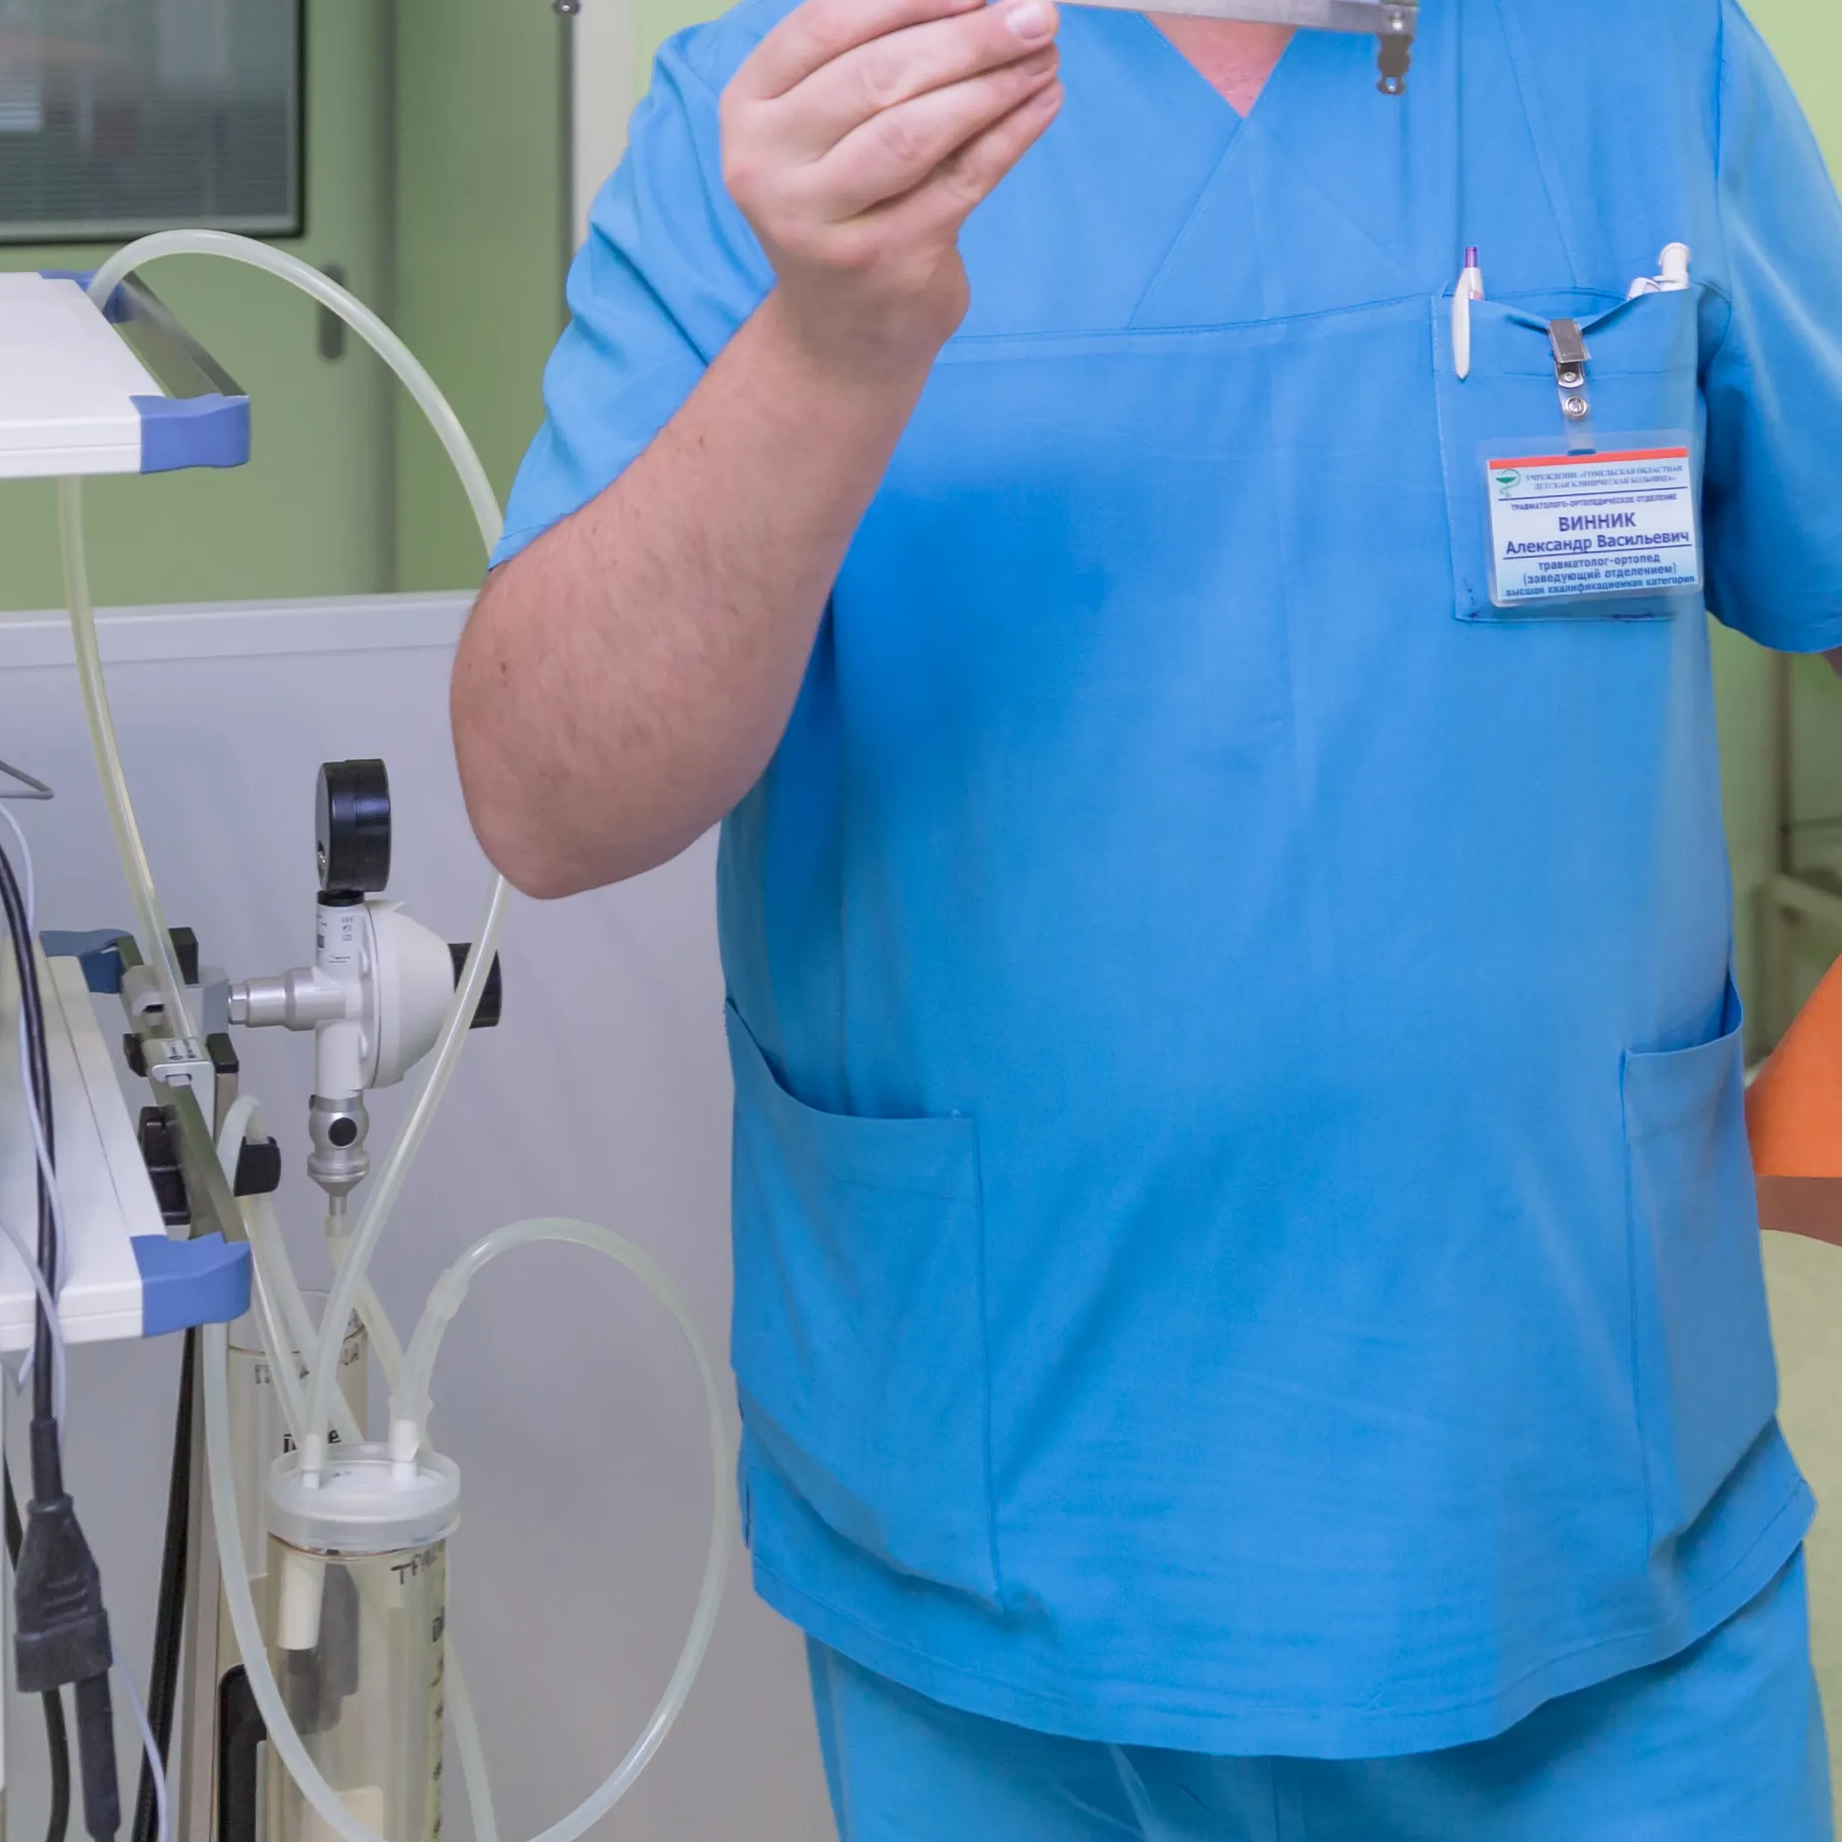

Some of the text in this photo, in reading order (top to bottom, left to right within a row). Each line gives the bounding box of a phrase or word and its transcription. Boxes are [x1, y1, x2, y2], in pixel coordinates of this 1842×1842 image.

[1558, 512, 1637, 532] ВИННИК
[1506, 531, 1690, 555] Александр Васильевич
[1538, 554, 1661, 572] травматолог-ортопед
[1523, 562, 1677, 586] (заведующий отделением)
[1547, 580, 1644, 595] квалификационная
[1645, 574, 1696, 587] категория
